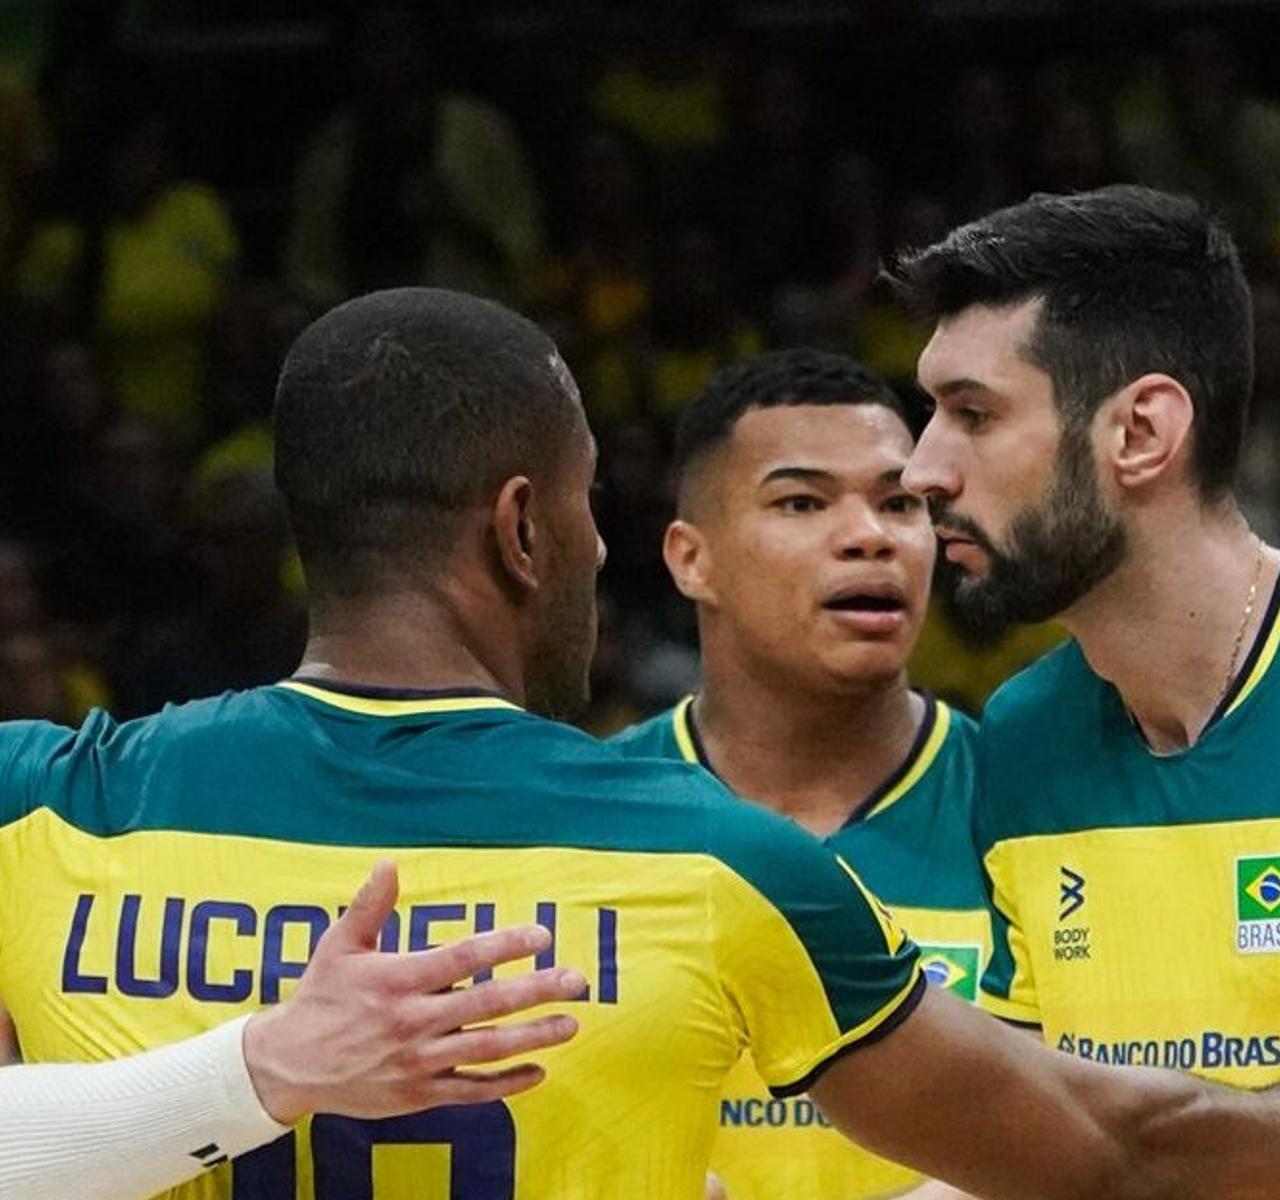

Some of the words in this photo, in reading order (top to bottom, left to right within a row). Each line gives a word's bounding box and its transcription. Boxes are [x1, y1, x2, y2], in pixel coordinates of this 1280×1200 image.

[1053, 928, 1090, 945] BODY
[1053, 945, 1091, 961] WORK
[1164, 1038, 1197, 1070] DO
[720, 1098, 787, 1128] NCO
